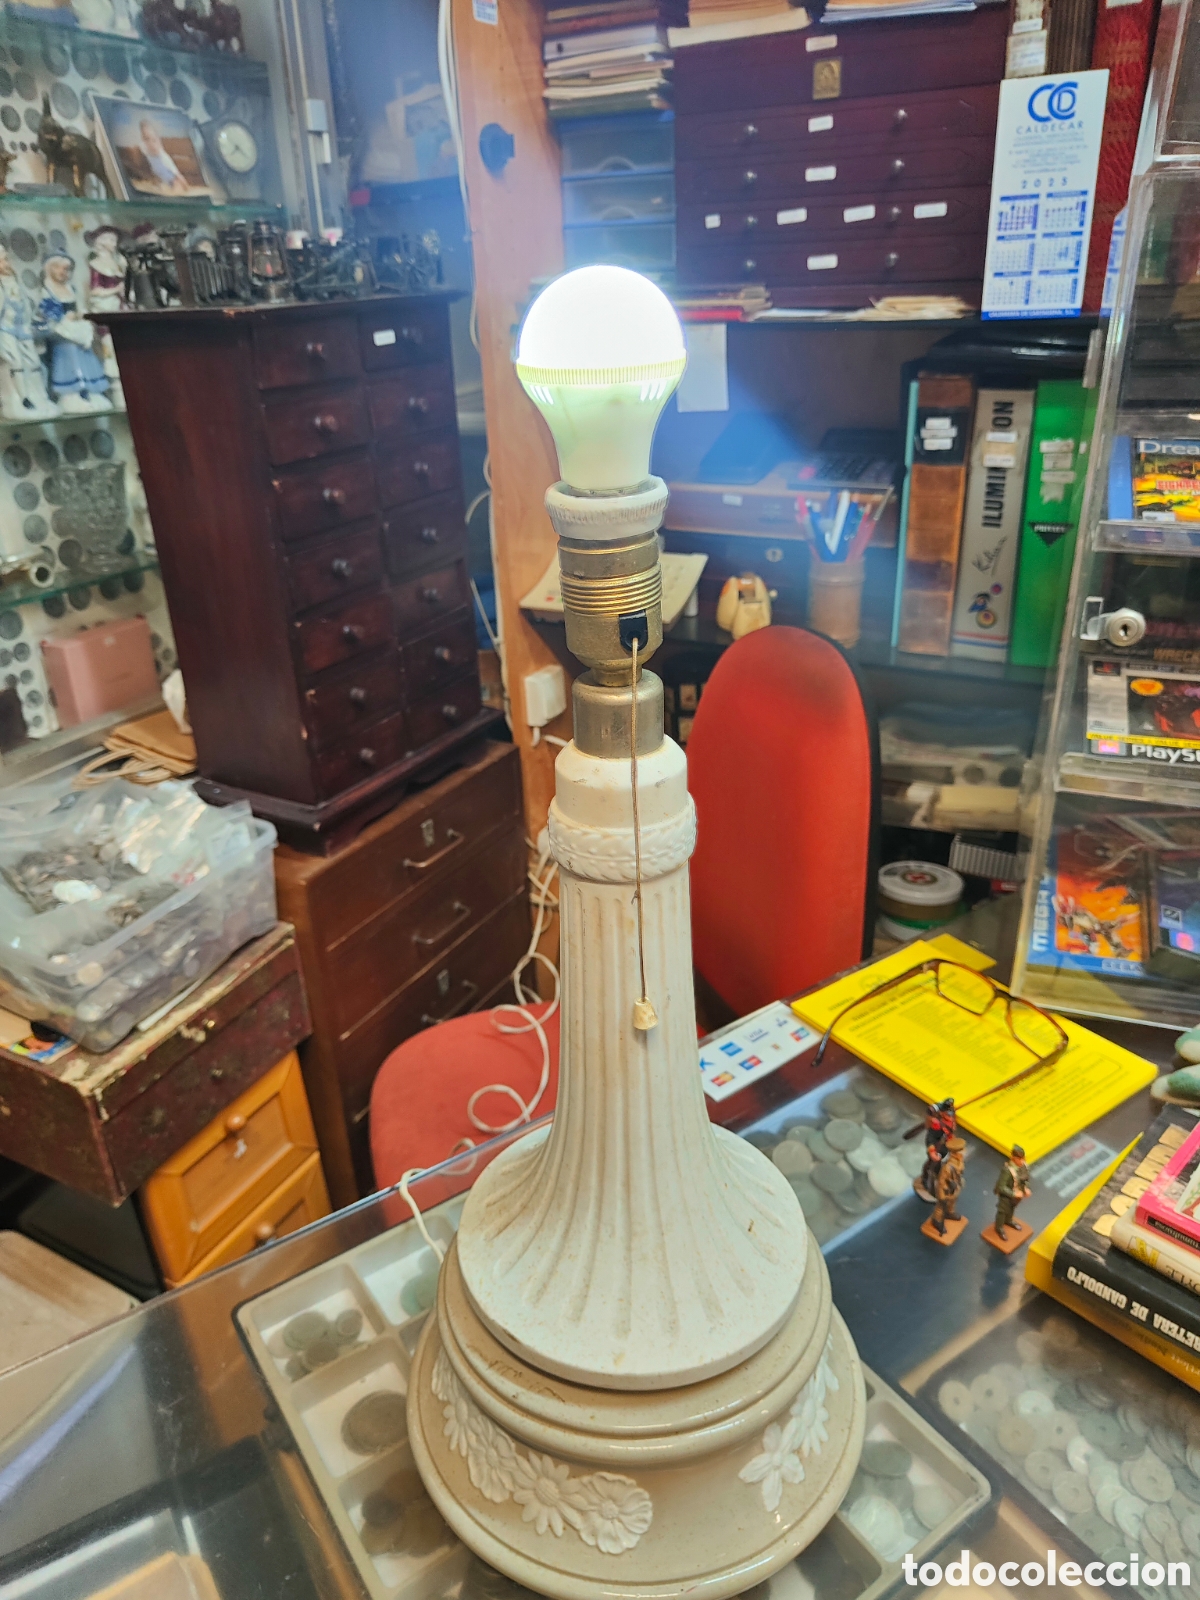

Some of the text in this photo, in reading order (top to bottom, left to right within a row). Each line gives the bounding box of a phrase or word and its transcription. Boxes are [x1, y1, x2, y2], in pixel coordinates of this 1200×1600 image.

[1016, 121, 1084, 134] CALDECAR
[1066, 1265, 1129, 1310] GANDOLFO
[1129, 1301, 1149, 1322] DE
